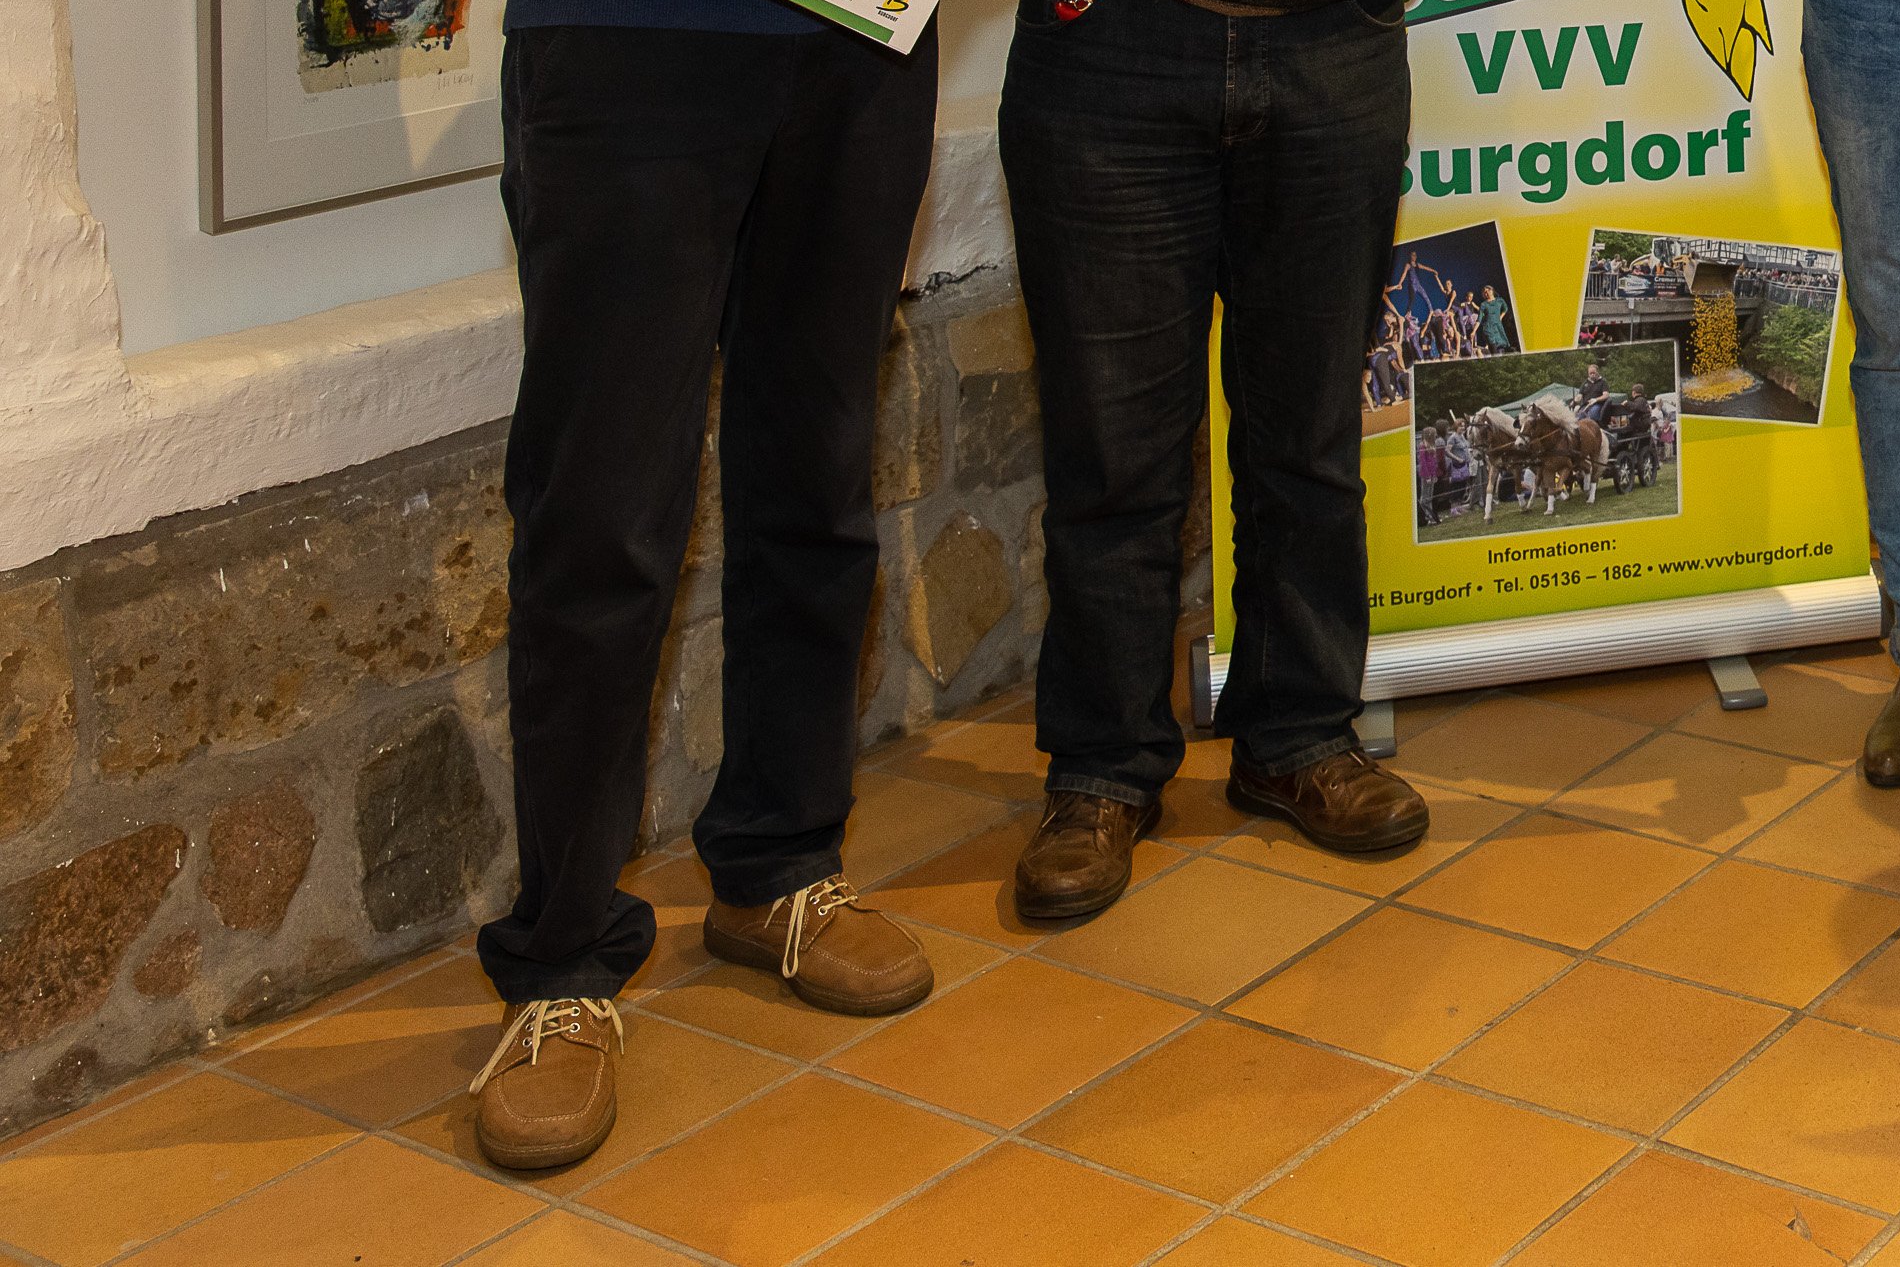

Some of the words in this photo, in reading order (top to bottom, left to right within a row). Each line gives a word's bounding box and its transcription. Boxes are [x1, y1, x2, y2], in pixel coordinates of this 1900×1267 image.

[1456, 22, 1643, 95] VVV
[1390, 582, 1473, 607] Burgdorf
[1493, 577, 1524, 594] Tel.
[1529, 570, 1581, 590] 05136
[1601, 563, 1642, 582] 1862
[1658, 541, 1834, 575] www.vvvburgdorf.de
[1487, 536, 1617, 565] Informationen:
